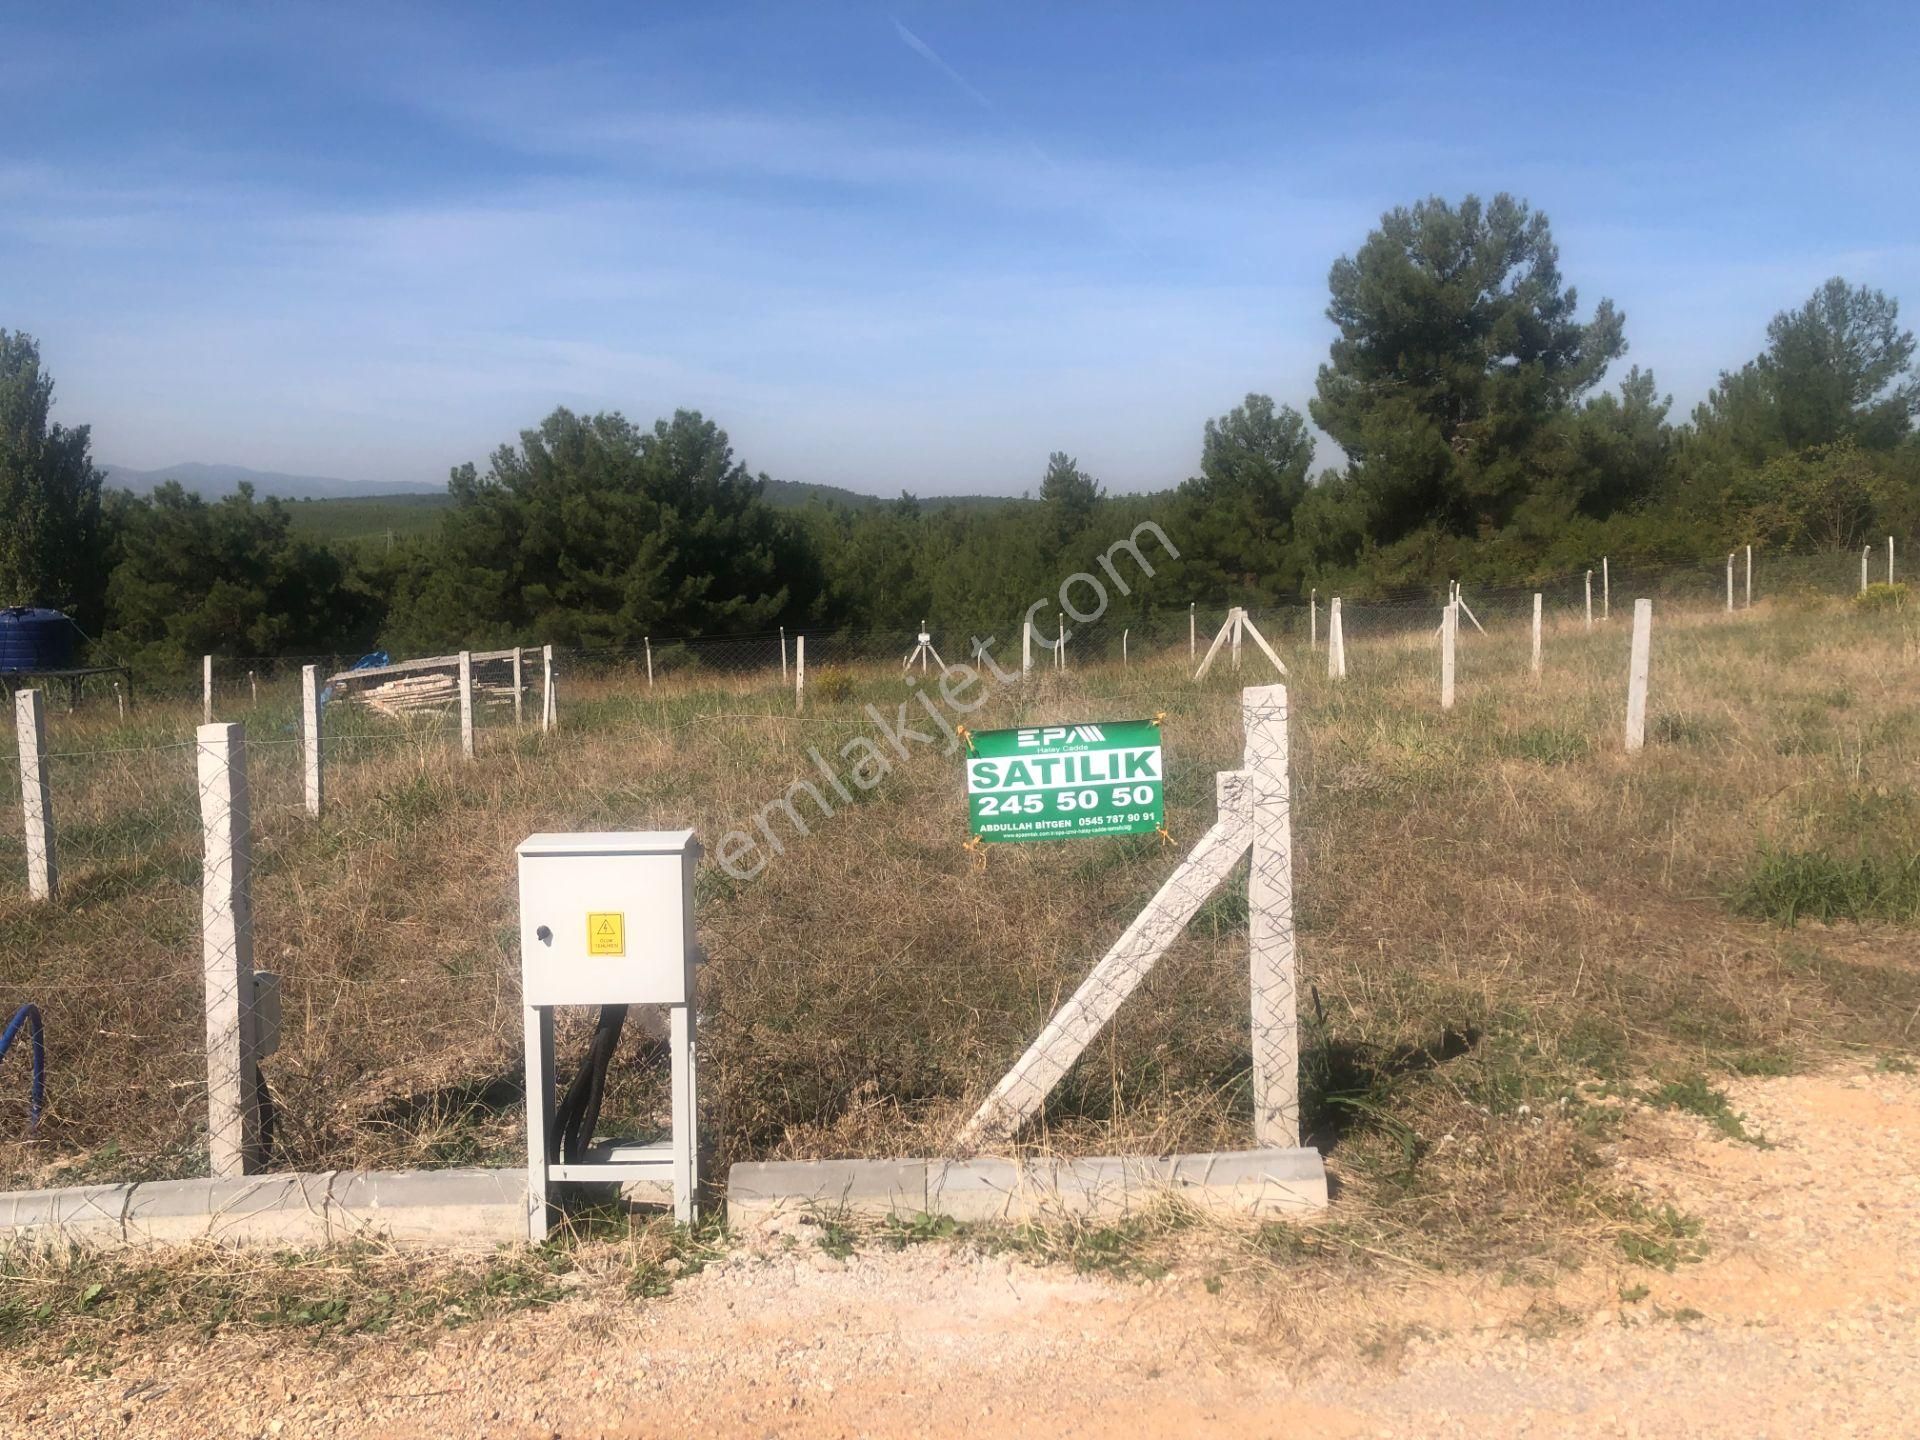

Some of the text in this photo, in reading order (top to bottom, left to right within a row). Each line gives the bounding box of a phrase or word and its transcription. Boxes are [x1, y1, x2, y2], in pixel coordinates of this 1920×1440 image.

[1062, 744, 1089, 752] Cadde
[972, 750, 1157, 789] SATILIK
[978, 785, 1154, 816] 245 50 50
[980, 812, 1155, 832] ABDULLAH BİTGEN 0545 787 90 91
